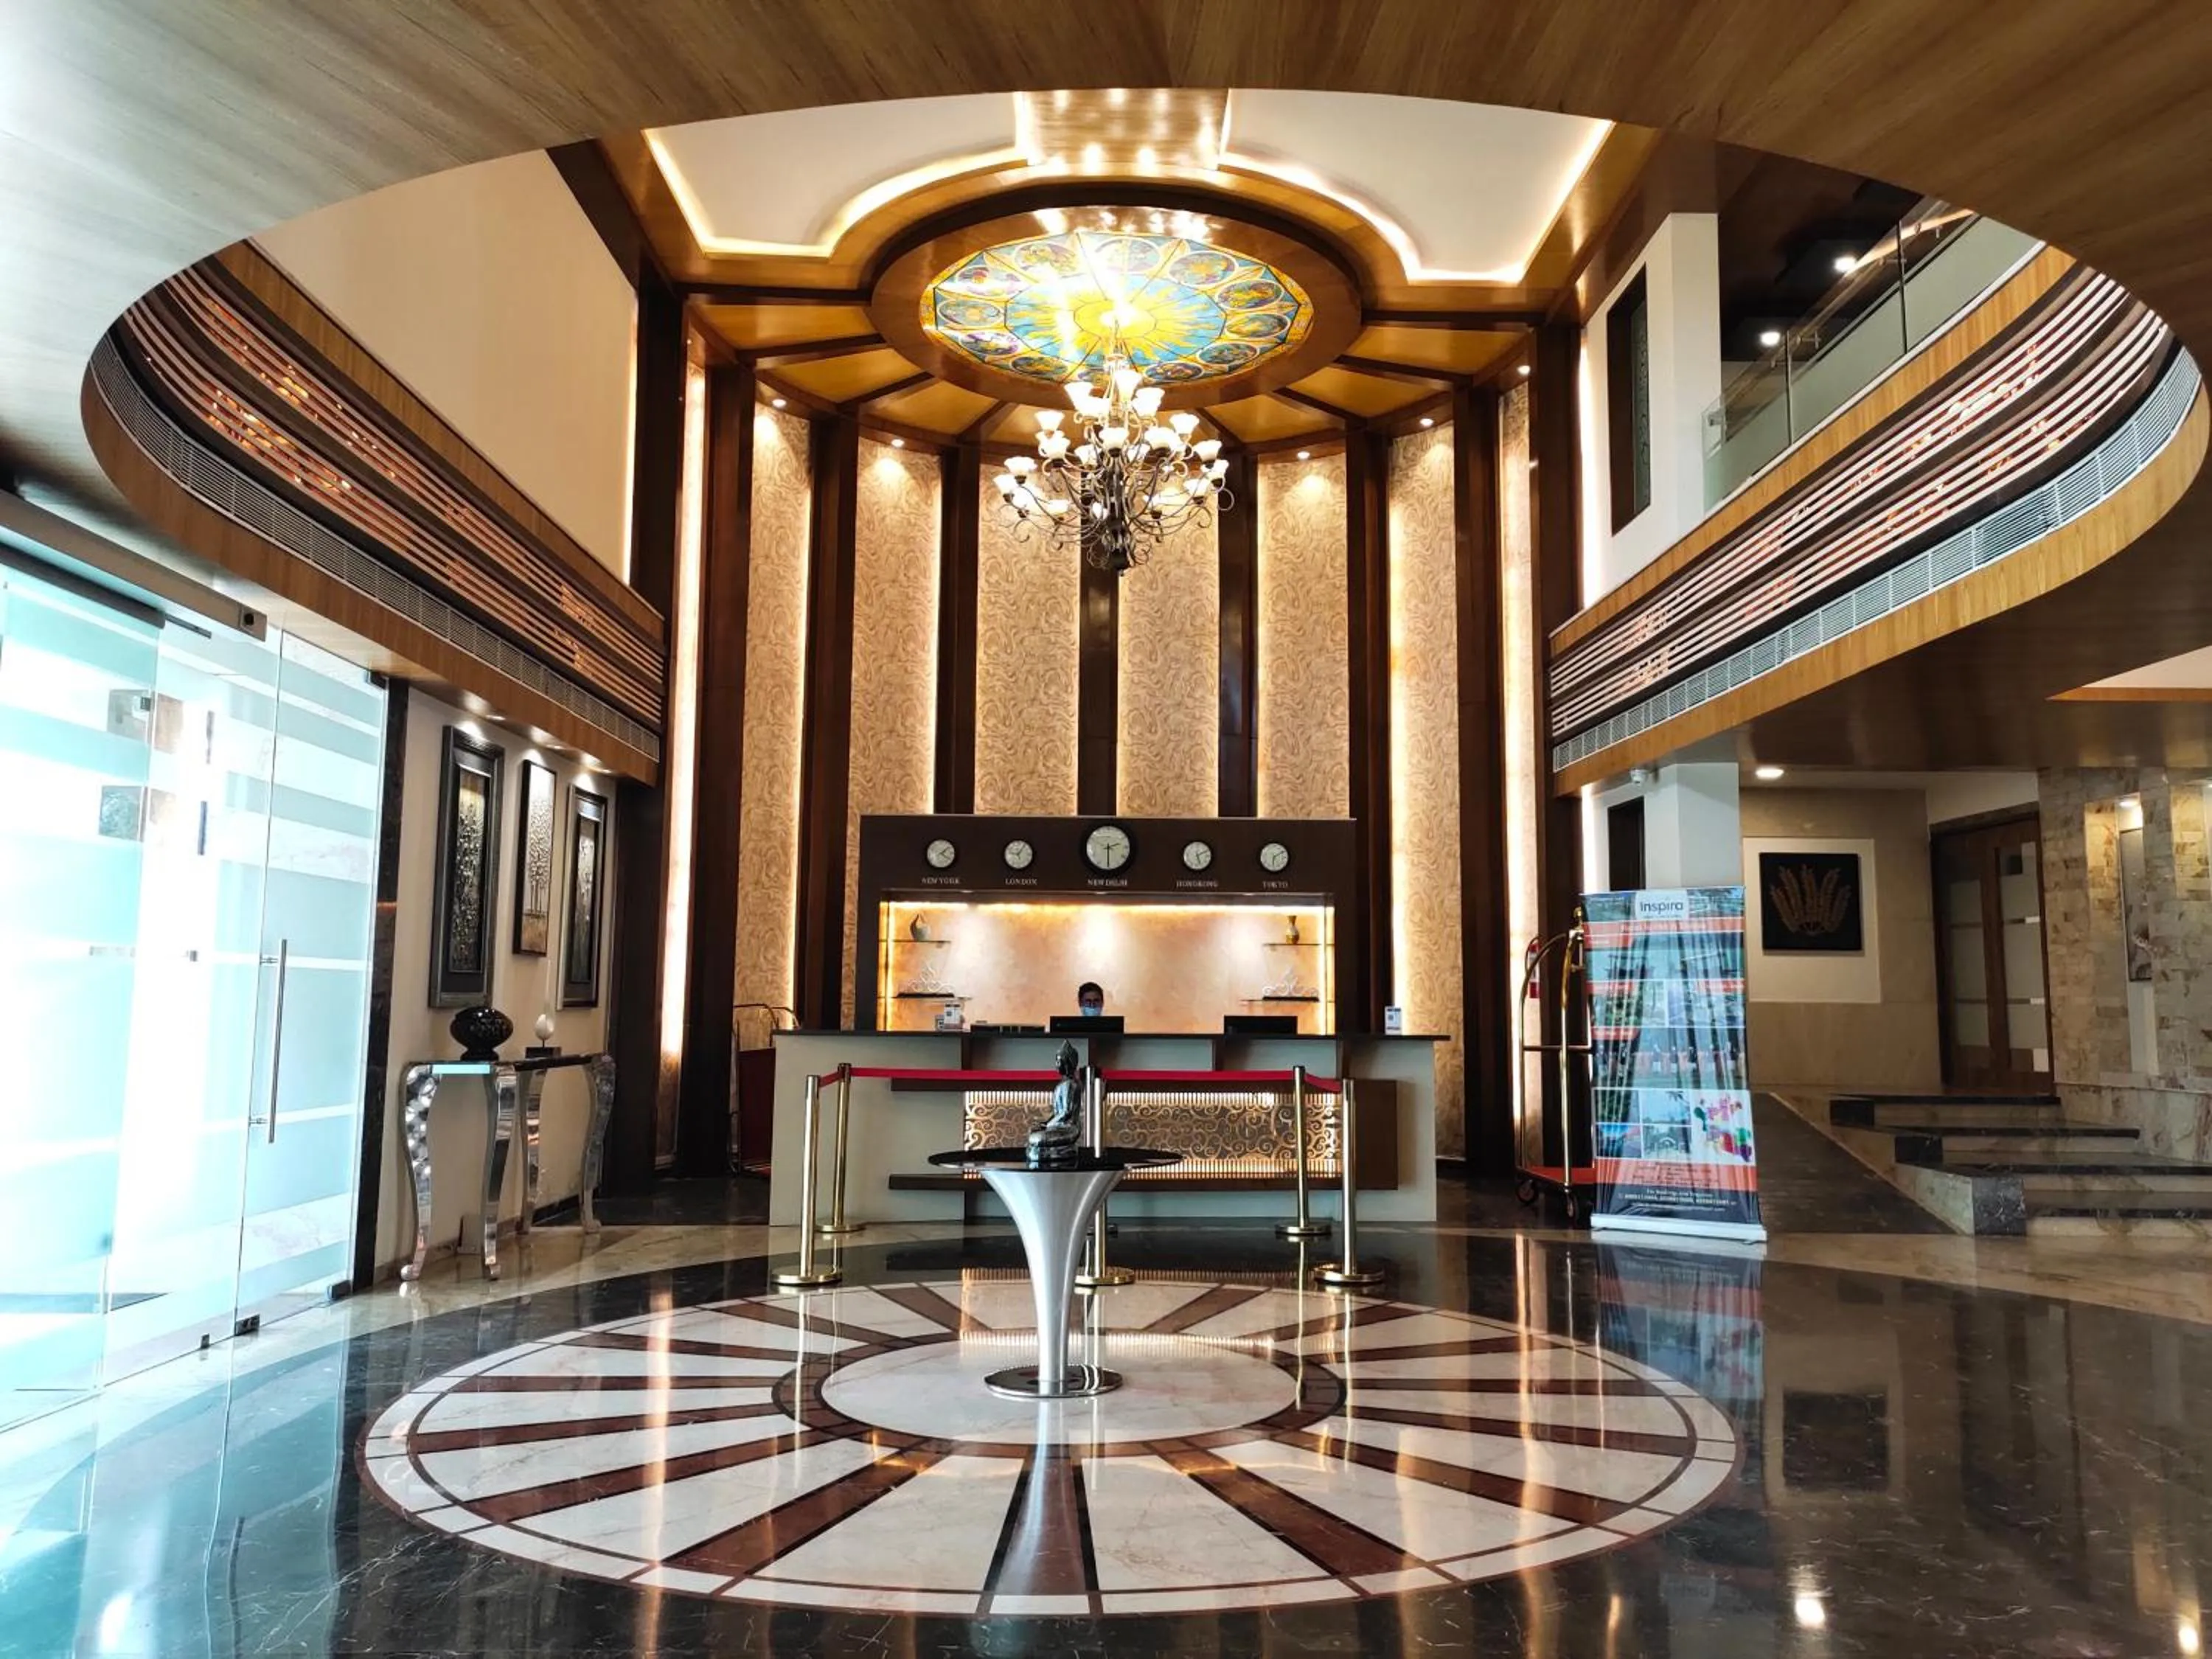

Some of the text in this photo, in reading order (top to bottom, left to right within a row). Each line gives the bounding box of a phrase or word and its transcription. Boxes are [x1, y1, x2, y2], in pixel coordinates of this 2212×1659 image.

[921, 877, 960, 885] NEW YORK
[1262, 880, 1289, 888] TOKYO
